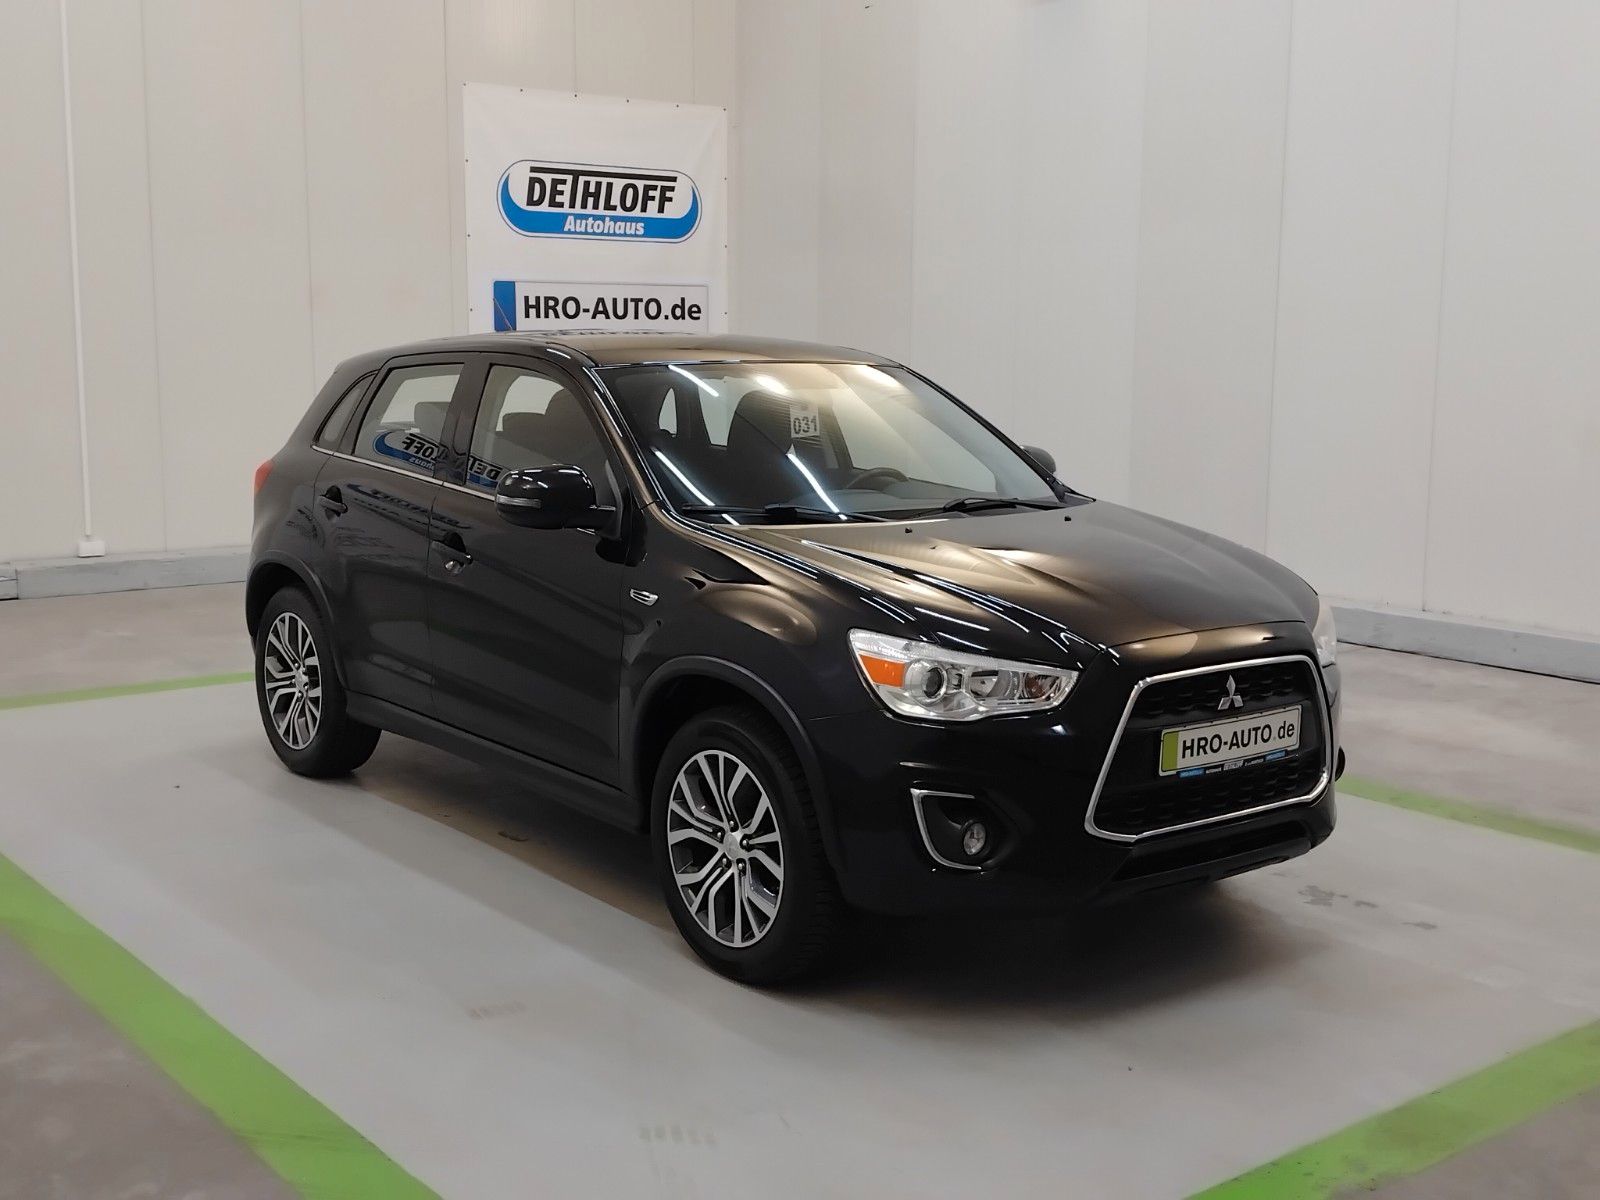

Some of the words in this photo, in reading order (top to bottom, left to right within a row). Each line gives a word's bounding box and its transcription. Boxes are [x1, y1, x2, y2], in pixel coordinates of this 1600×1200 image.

[526, 166, 677, 214] DETHLOFF
[564, 215, 645, 236] Autohaus
[523, 295, 702, 321] HRO-AUTO.de
[793, 416, 817, 434] 031
